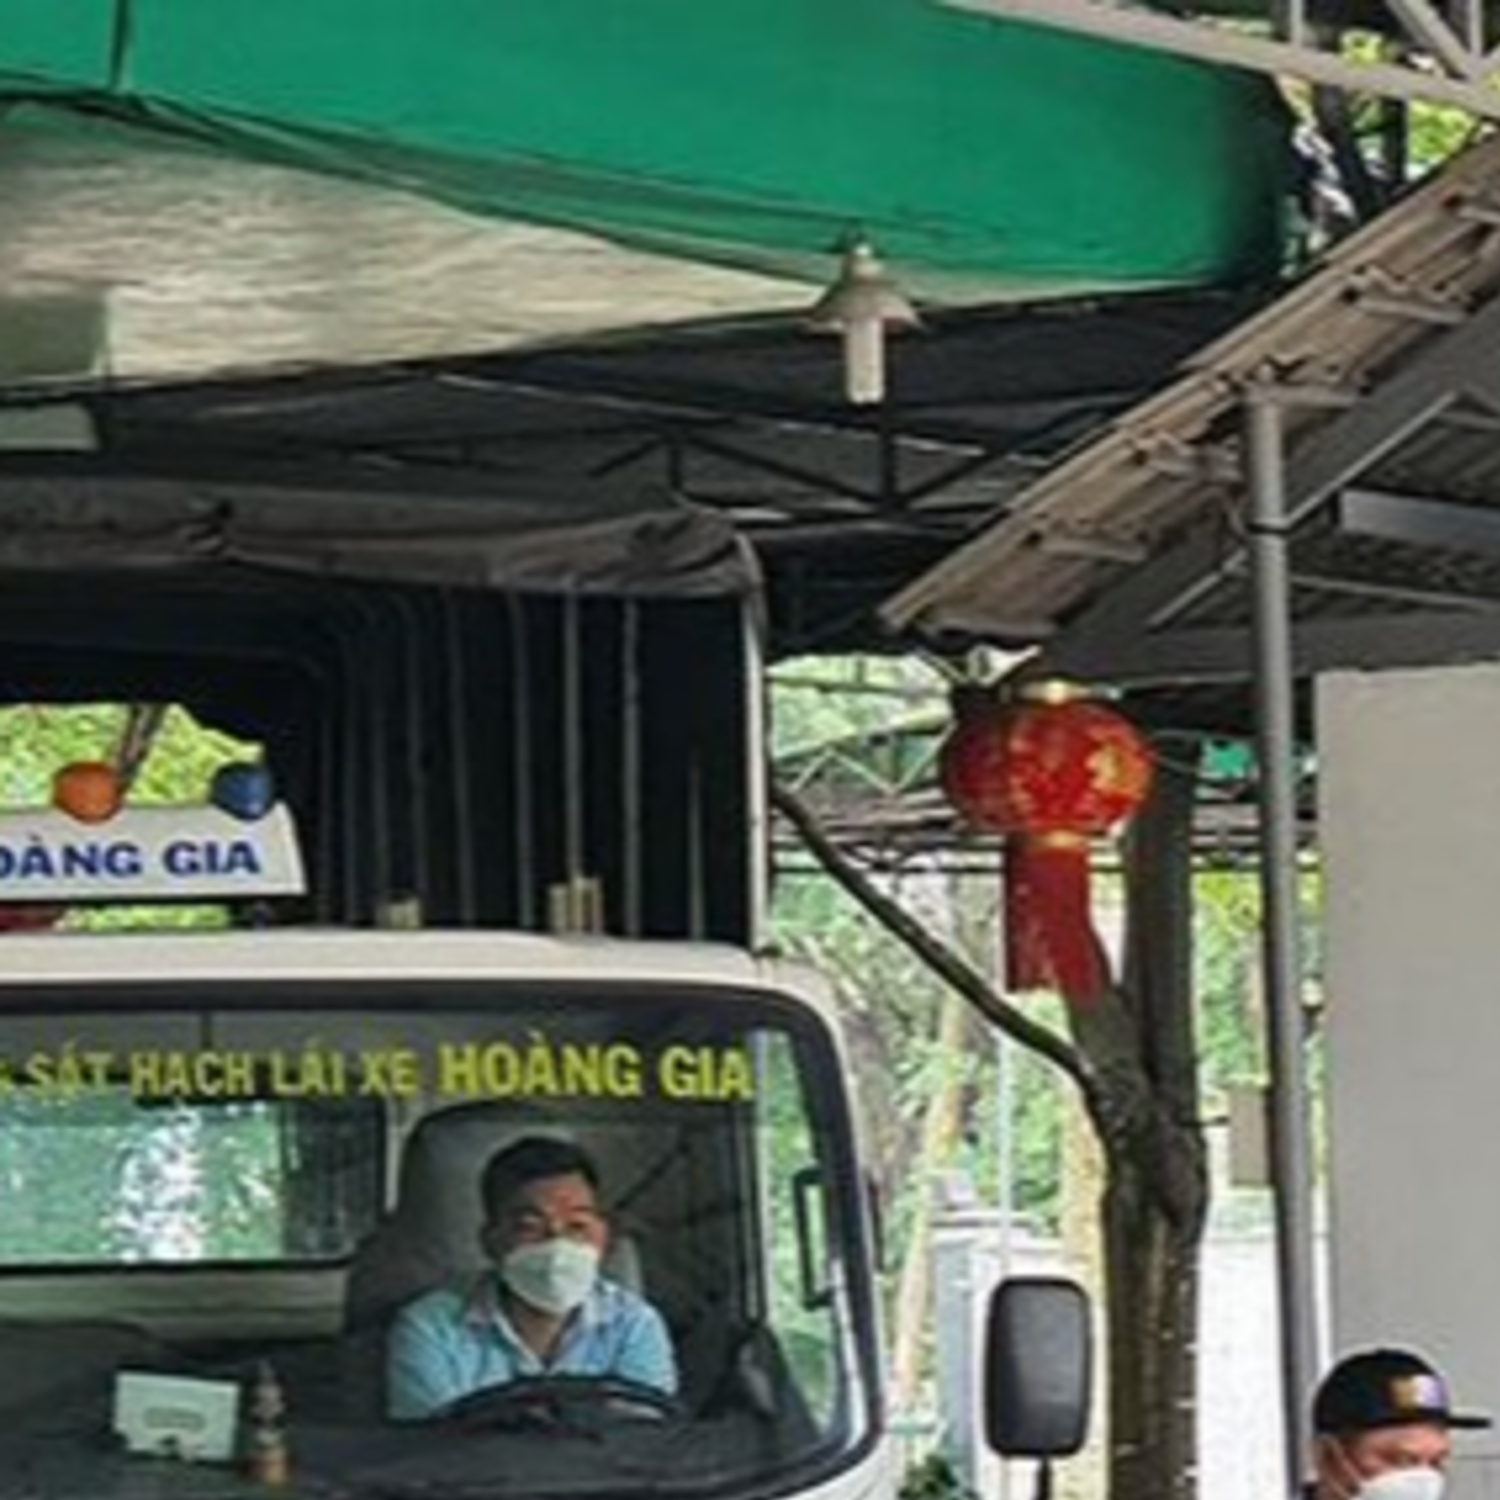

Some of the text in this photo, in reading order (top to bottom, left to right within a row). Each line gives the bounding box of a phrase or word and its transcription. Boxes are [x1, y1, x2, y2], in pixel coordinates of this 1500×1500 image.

[163, 839, 260, 876] GIA
[24, 1038, 114, 1087] SÁT
[273, 1037, 347, 1093] LÁI
[359, 1052, 419, 1093] XE
[438, 1029, 642, 1096] HOÀNG
[657, 1045, 754, 1098] GIA
